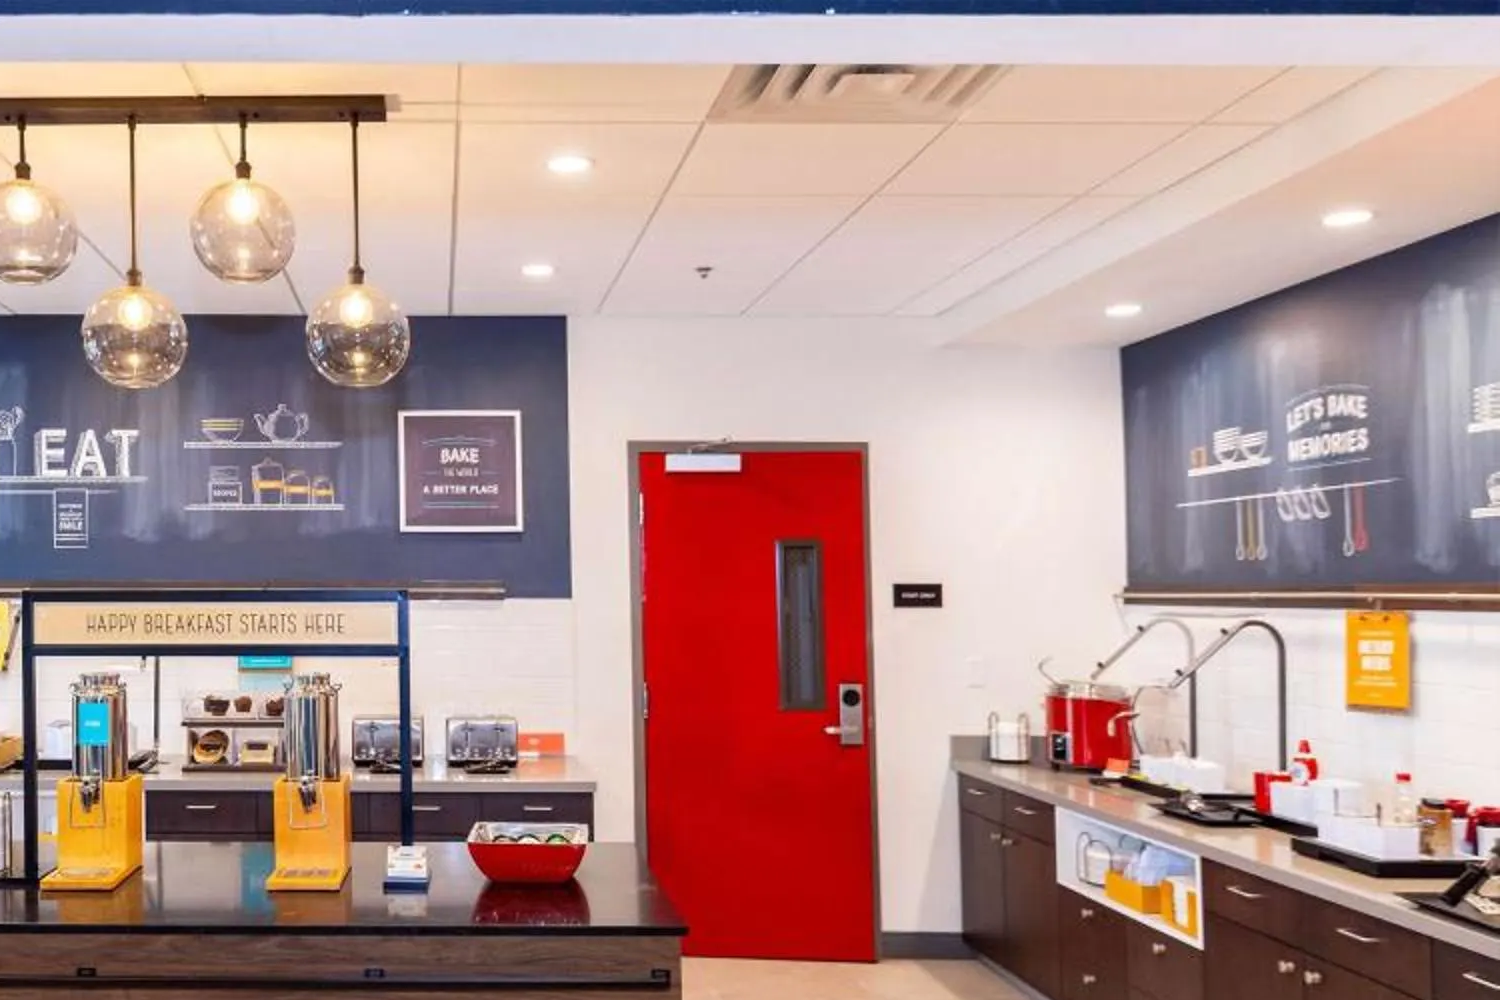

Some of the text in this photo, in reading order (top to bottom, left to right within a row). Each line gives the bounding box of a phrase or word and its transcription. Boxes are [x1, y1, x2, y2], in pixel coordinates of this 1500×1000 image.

[1327, 393, 1369, 419] BAKE
[34, 428, 140, 478] EAT
[440, 447, 480, 464] BAKE
[1287, 427, 1370, 462] MEMORIES
[423, 485, 430, 495] A
[469, 484, 499, 495] PLACE
[85, 613, 346, 635] HAPPY BREAKFAST STARTS HERE
